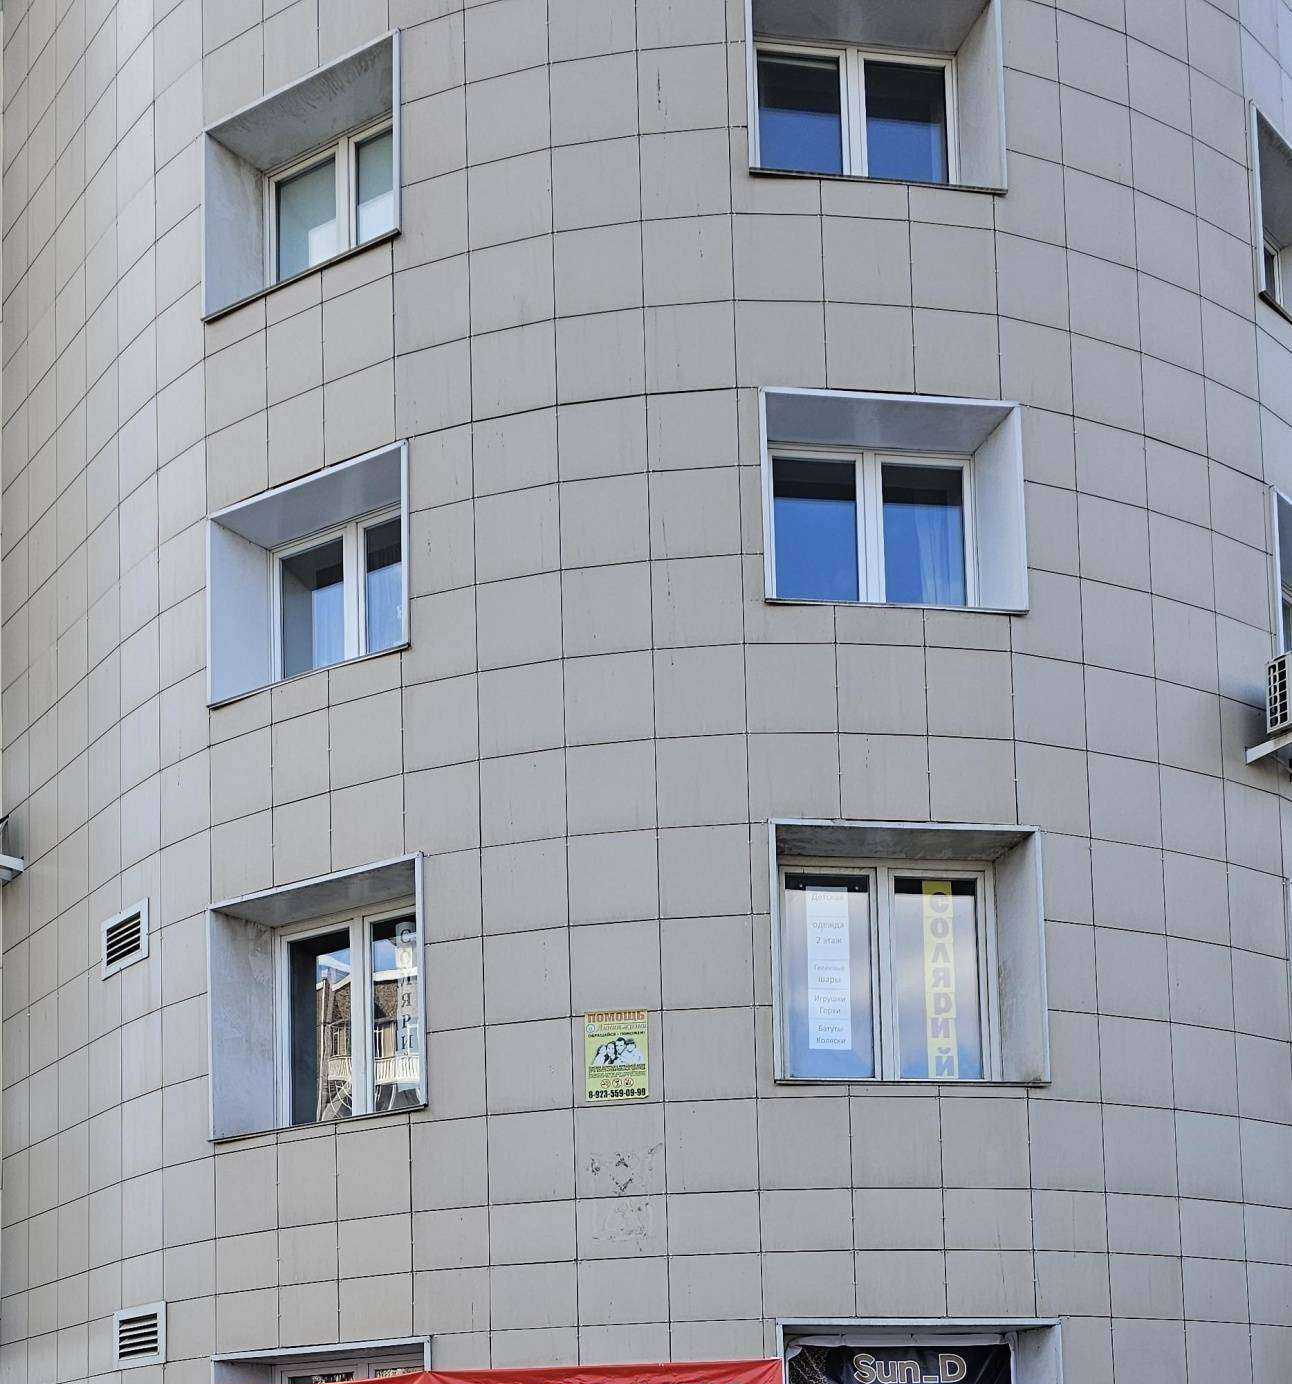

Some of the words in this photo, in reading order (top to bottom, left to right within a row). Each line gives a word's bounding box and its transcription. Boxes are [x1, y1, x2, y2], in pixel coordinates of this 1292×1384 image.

[815, 936, 821, 945] 2
[930, 892, 955, 1077] СОЛЯРИЙ
[587, 1011, 646, 1023] ПОМОЩЬ
[853, 1353, 967, 1384] Sun_D
